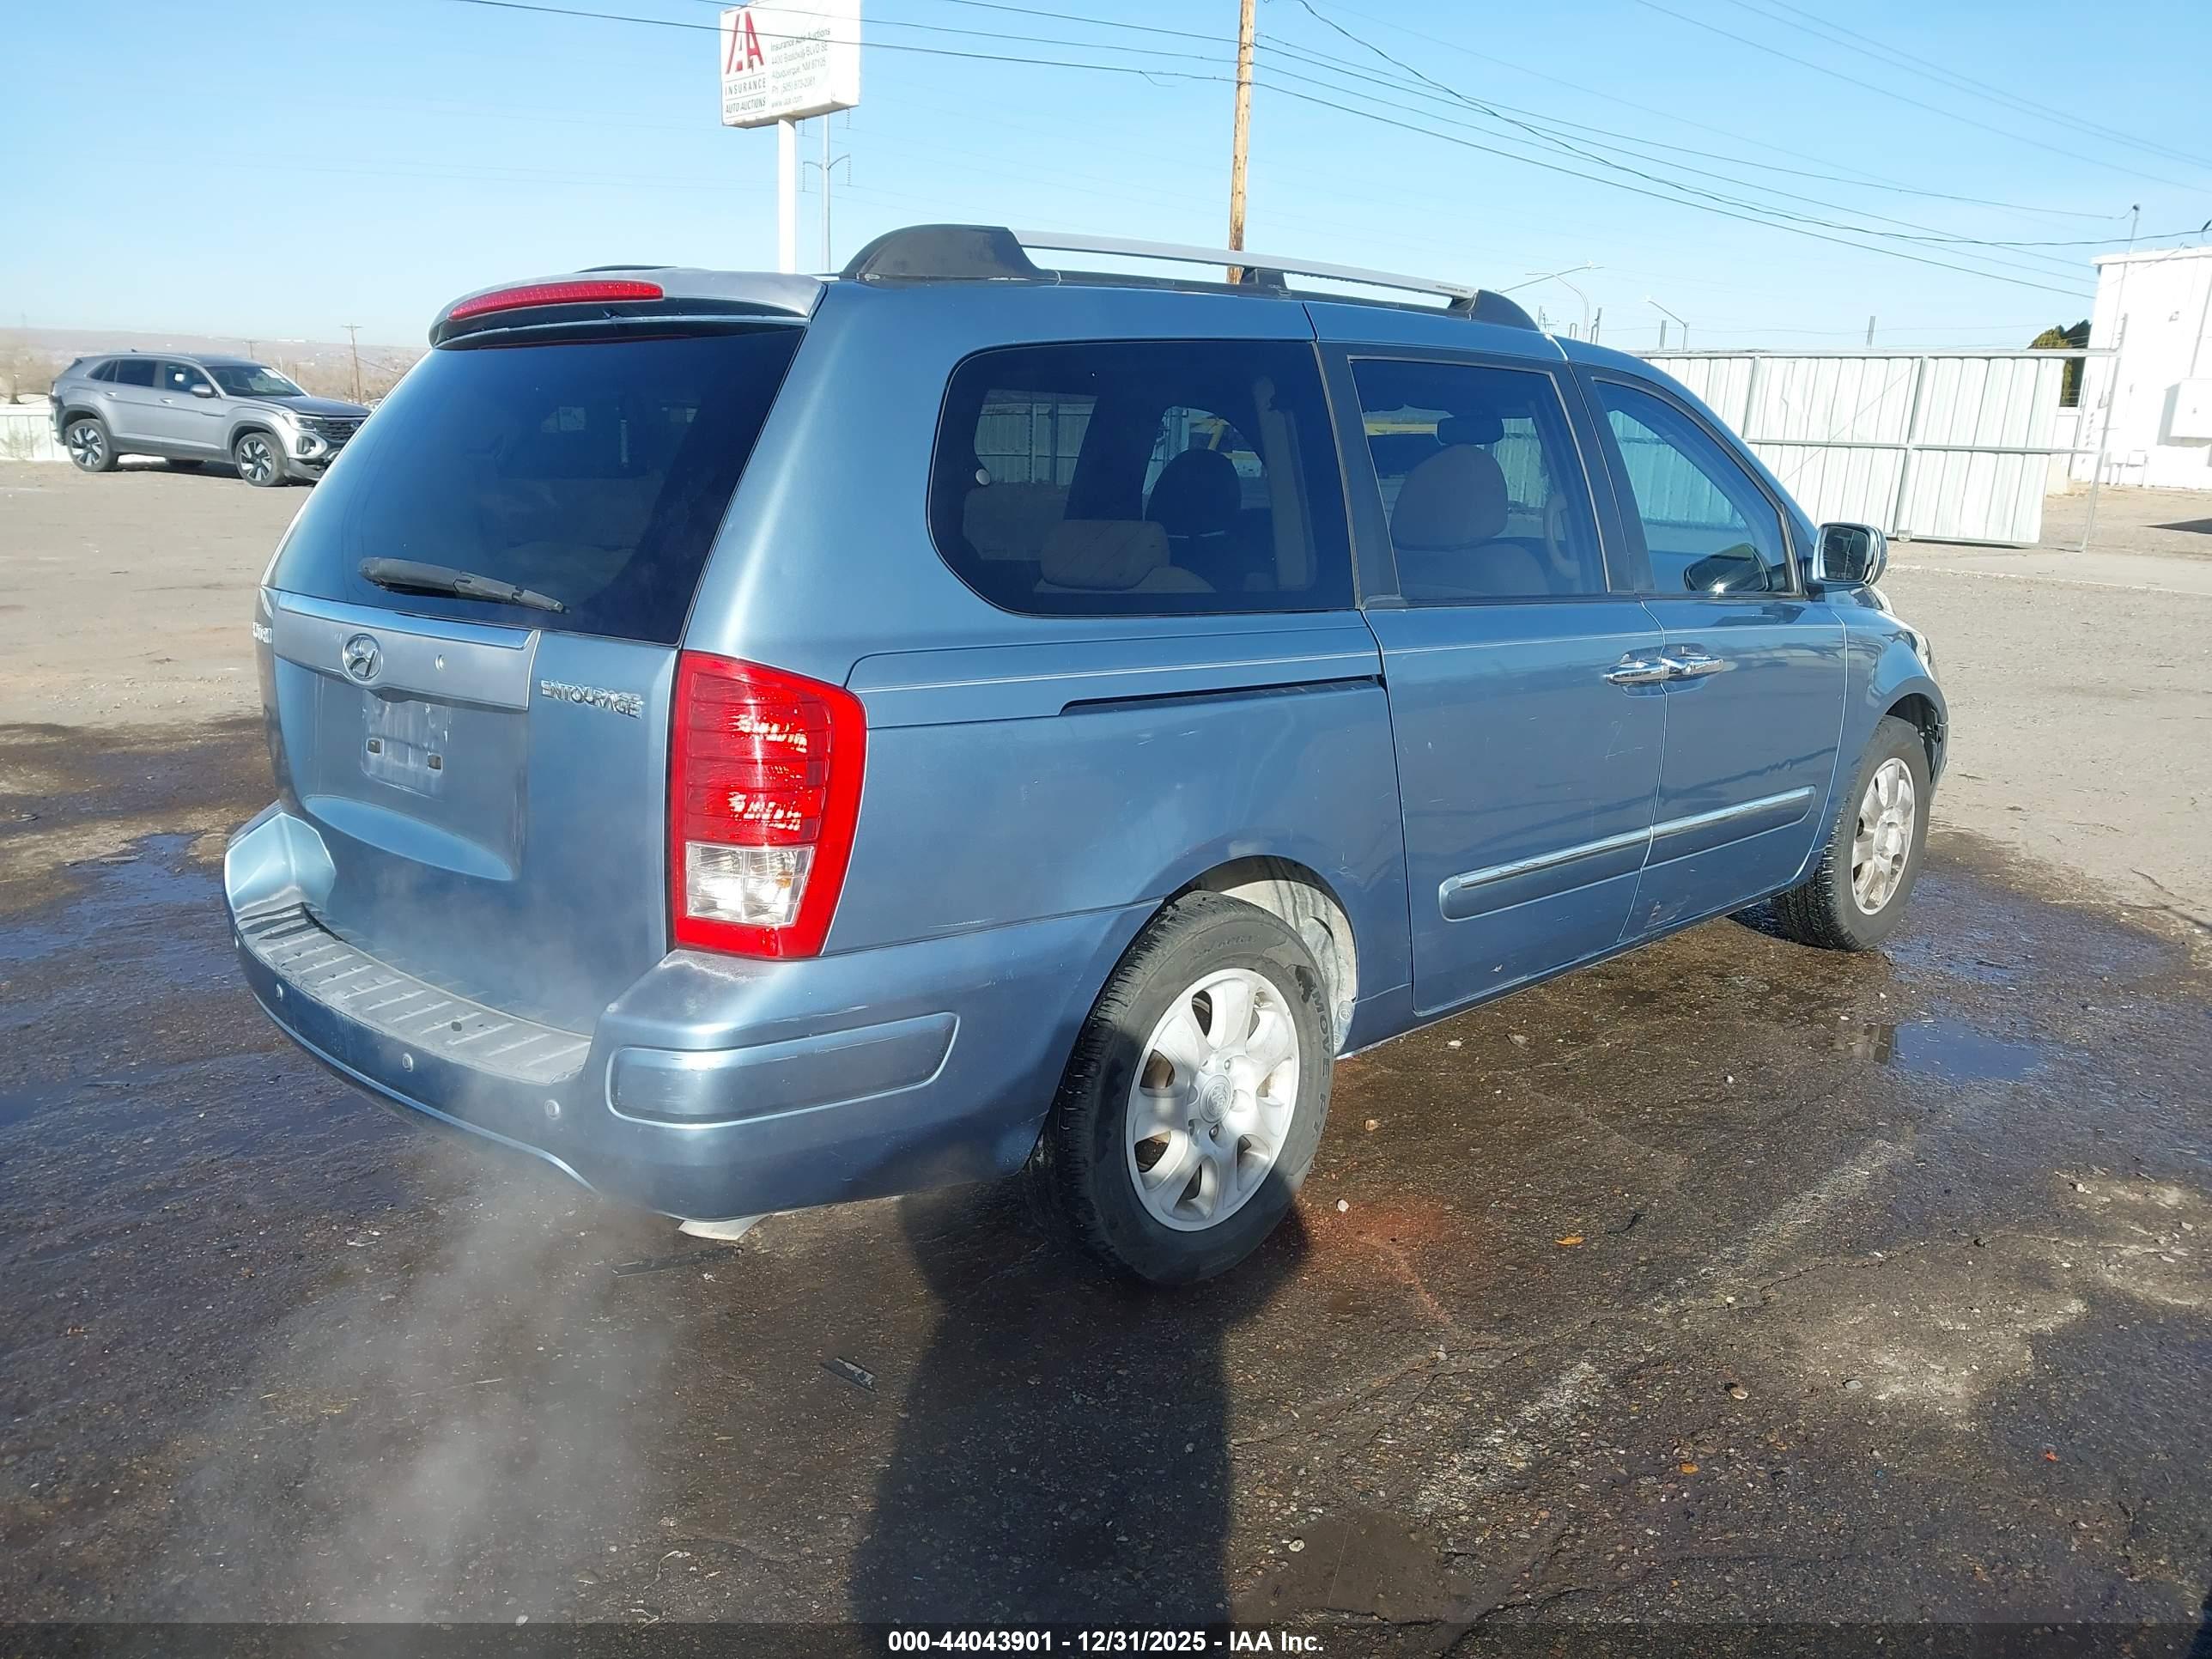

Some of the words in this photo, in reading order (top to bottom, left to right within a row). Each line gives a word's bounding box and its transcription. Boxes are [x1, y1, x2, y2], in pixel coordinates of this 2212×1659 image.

[725, 78, 766, 96] INSURANCE
[726, 102, 739, 113] AUTO
[739, 97, 766, 111] AUCTIONS
[540, 679, 644, 720] ENTOURAGE
